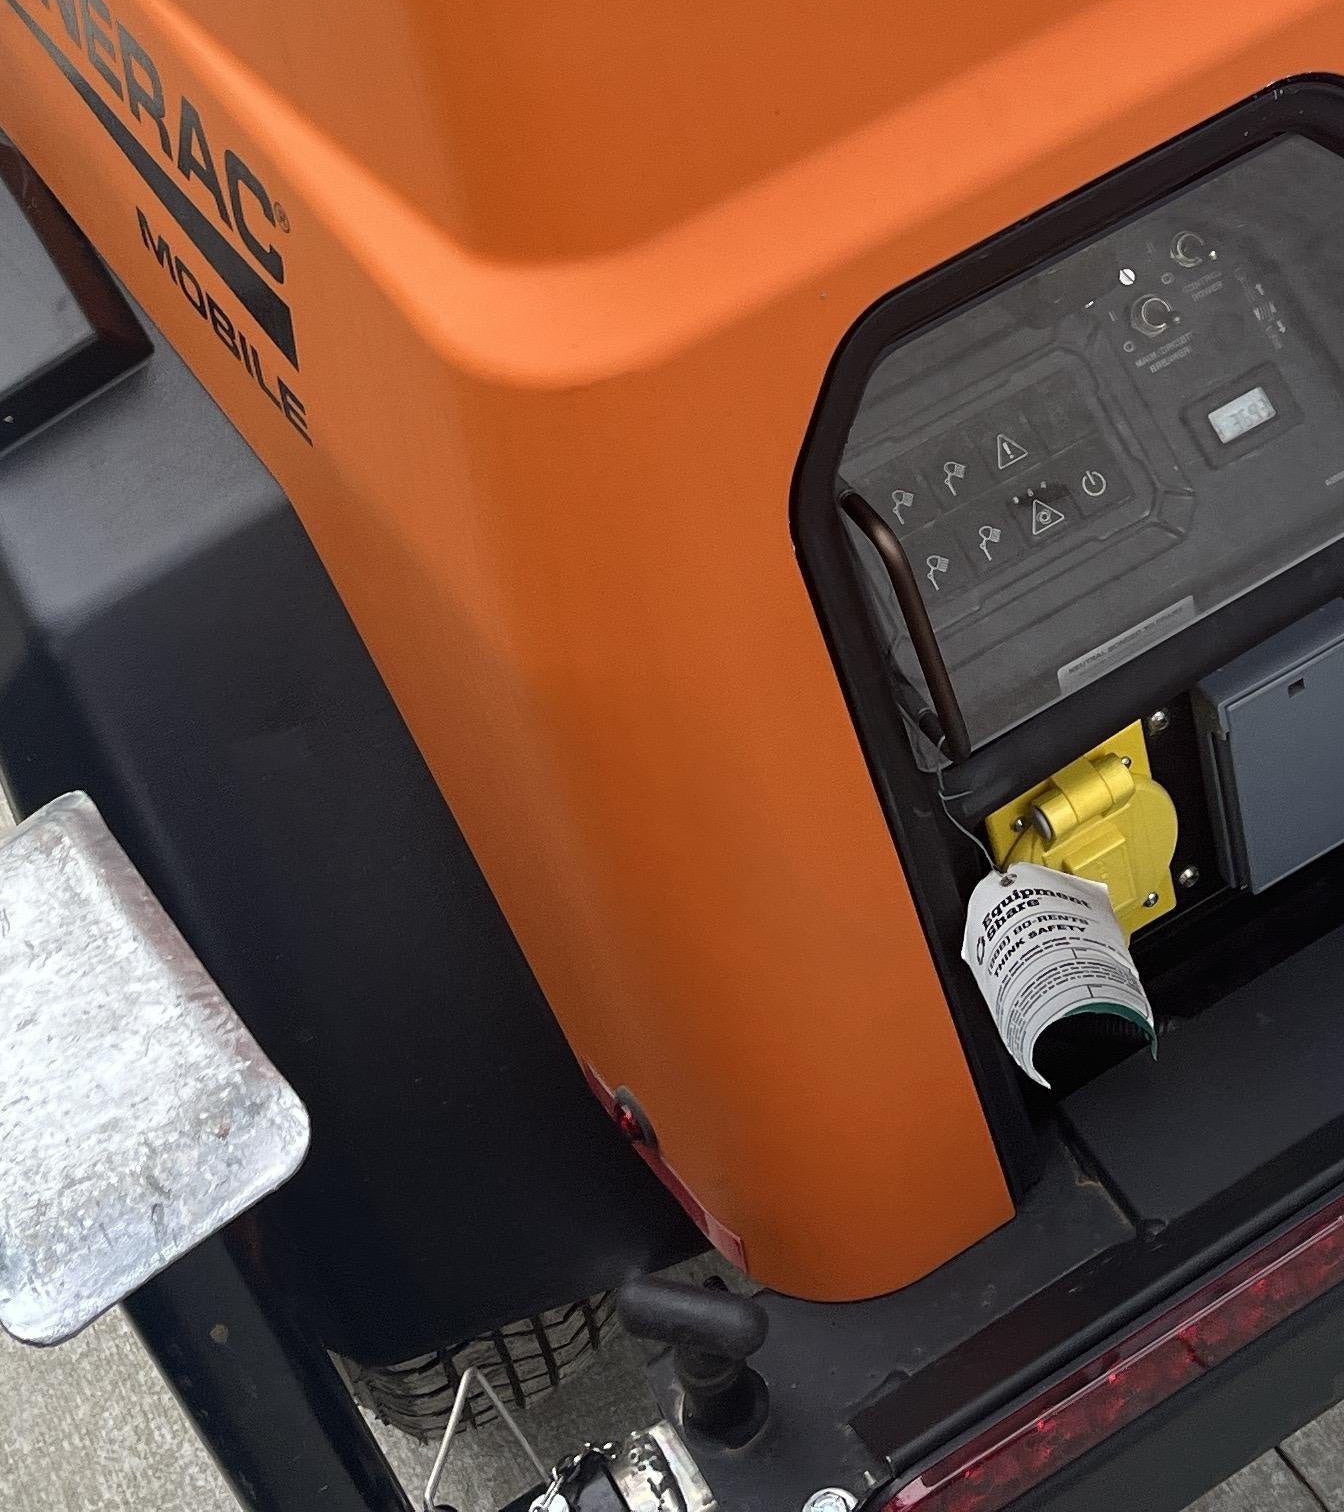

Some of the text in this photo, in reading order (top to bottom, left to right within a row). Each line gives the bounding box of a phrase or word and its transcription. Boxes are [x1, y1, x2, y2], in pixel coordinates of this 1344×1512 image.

[135, 205, 315, 447] MOBILE
[982, 887, 1093, 931] Equipment
[986, 897, 1041, 941] Share
[993, 923, 1087, 978] THINK SAFETY
